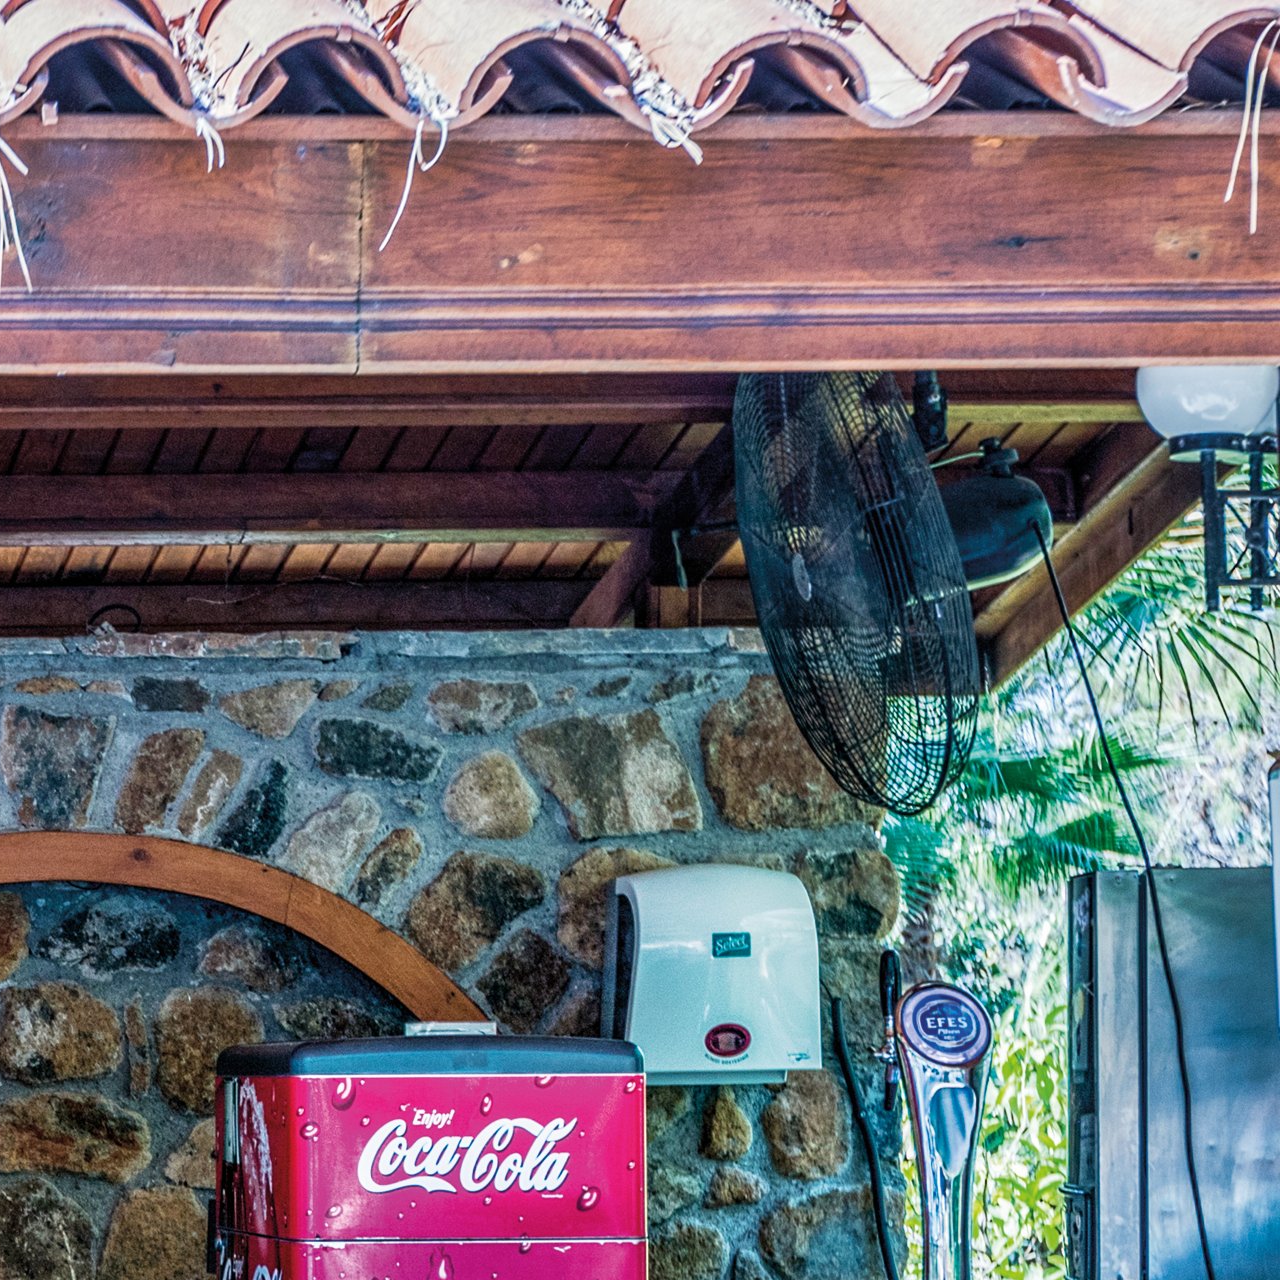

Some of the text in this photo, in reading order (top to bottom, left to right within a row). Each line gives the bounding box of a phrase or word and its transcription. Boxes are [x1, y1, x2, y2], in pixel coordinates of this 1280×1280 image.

[926, 1016, 968, 1029] EFES
[412, 1109, 455, 1129] Enjoy!
[357, 1117, 578, 1193] Coca-Cola
